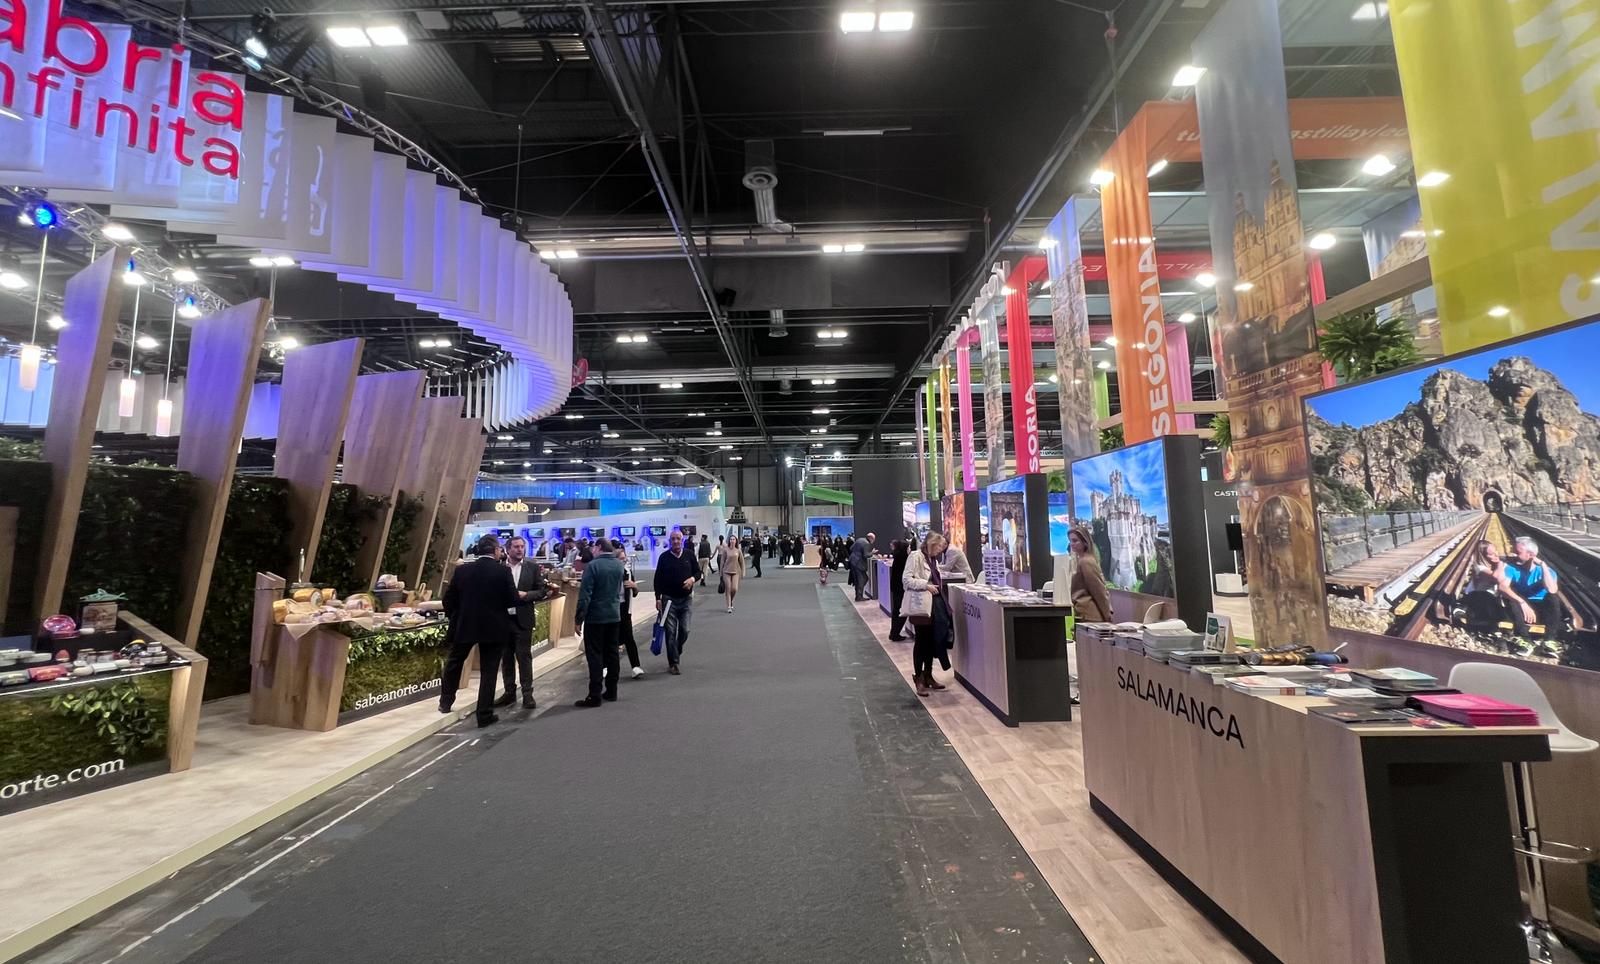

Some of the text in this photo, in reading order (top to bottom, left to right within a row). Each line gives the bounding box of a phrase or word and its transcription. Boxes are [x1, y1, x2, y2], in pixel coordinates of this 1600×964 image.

[1138, 239, 1172, 436] SEGOVIA
[1024, 384, 1039, 473] SORIA
[354, 677, 442, 711] sabeanorte.com
[1117, 666, 1244, 749] SALAMANCA
[0, 758, 125, 799] orte.com
